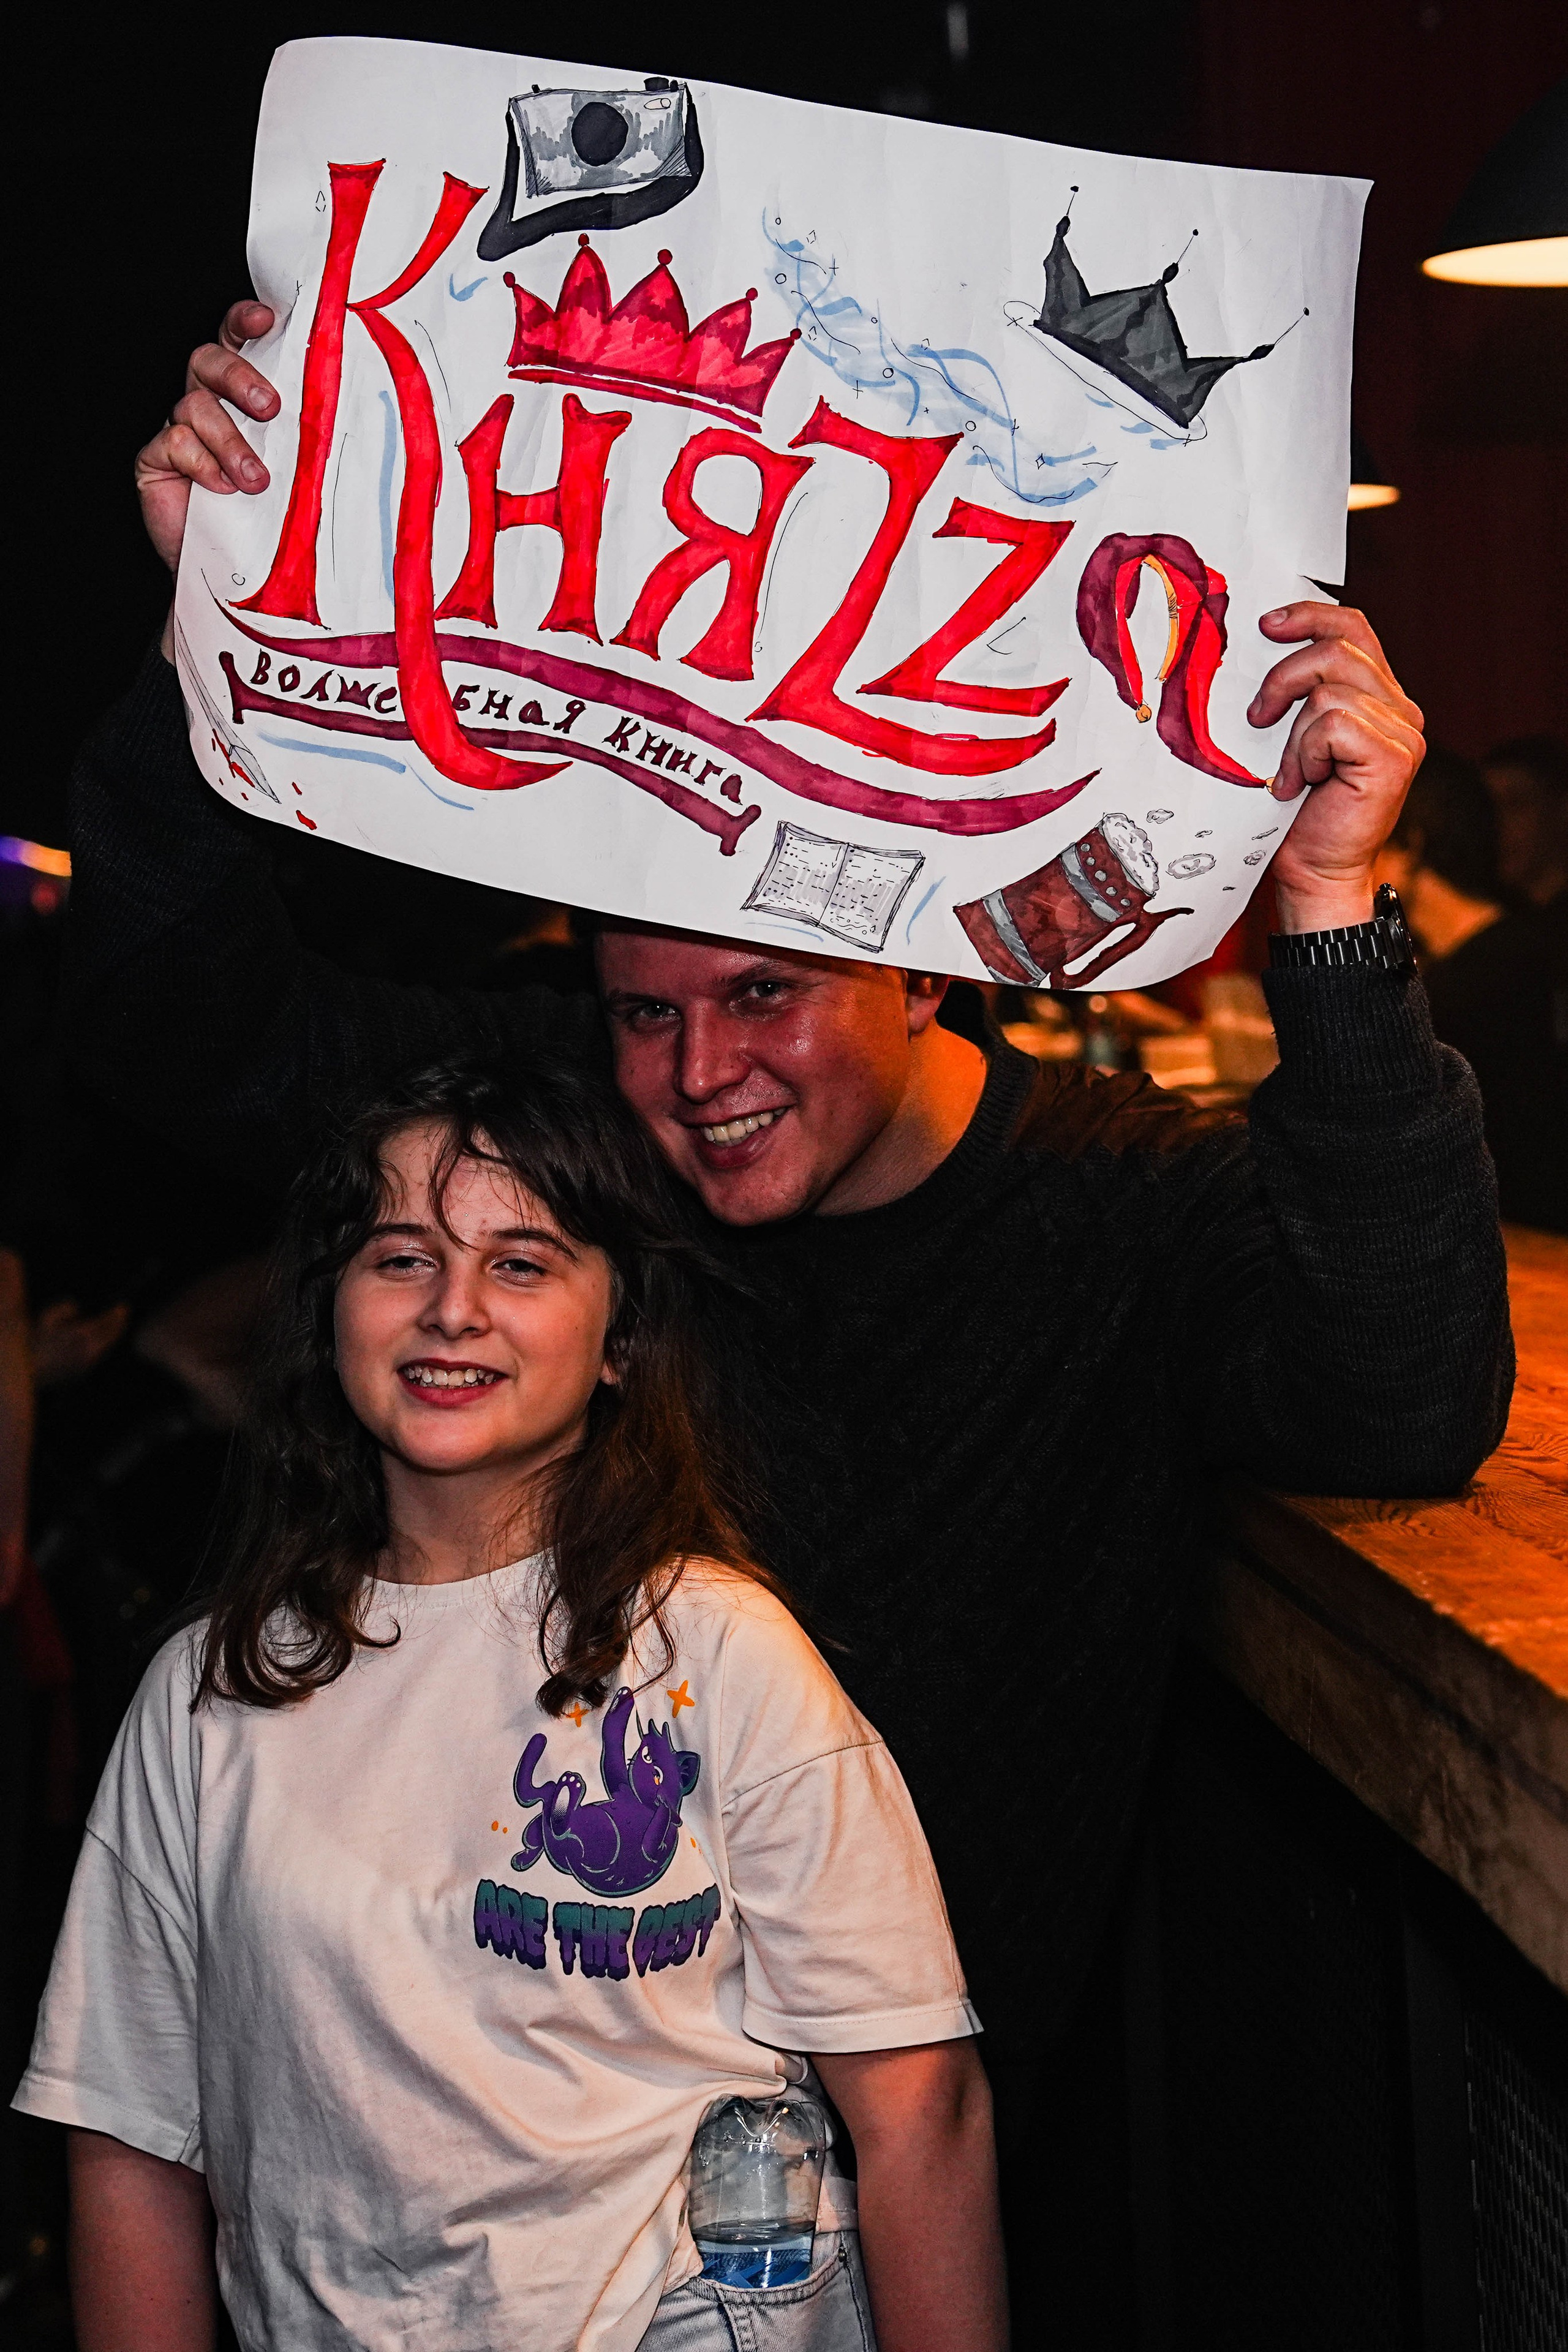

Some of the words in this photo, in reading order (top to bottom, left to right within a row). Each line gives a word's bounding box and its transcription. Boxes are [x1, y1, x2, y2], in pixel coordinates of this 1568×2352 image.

[474, 1879, 548, 1970] ARE
[554, 1902, 635, 1981] THE
[633, 1883, 721, 1978] BEST
